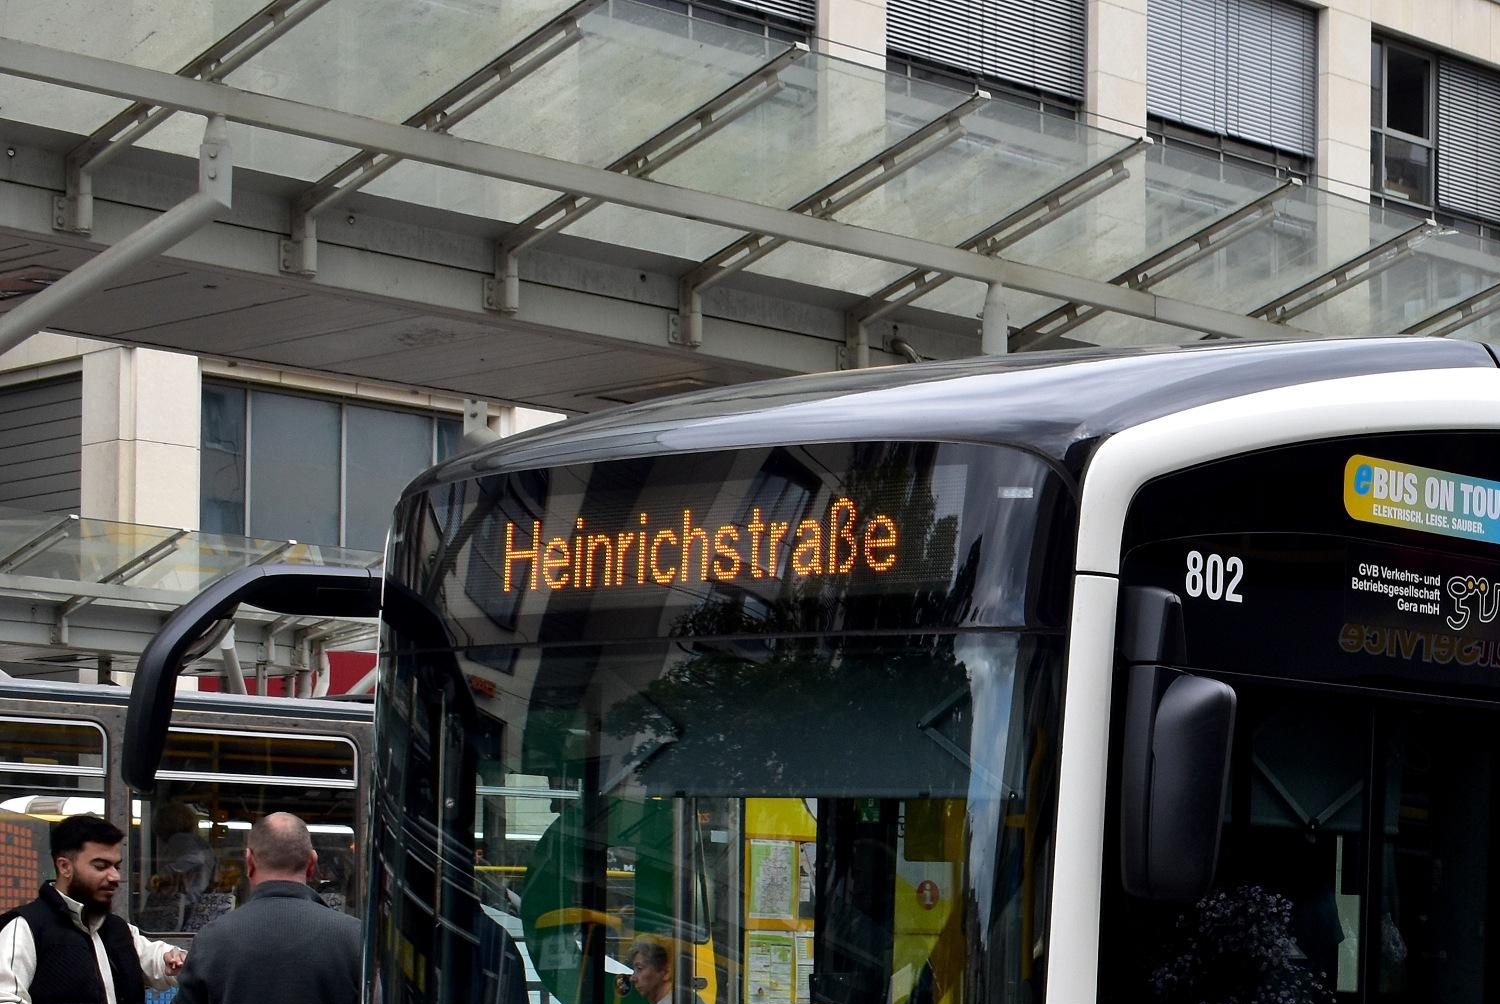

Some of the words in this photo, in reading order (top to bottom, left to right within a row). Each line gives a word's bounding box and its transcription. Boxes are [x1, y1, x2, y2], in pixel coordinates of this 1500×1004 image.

[1425, 477, 1455, 512] ON
[1373, 503, 1424, 524] ELEKTRISCH.
[1425, 513, 1450, 528] LEISE.
[1452, 517, 1485, 534] SAUBER.
[503, 496, 897, 593] Heinrichstraße
[1185, 550, 1244, 604] 802
[1351, 577, 1441, 601] Betriebsgesellschaft
[1359, 563, 1379, 577] GVB
[1381, 566, 1423, 583] Verkehrs-
[1424, 575, 1441, 586] und
[1397, 598, 1418, 613] Gera
[1419, 603, 1440, 615] mbH
